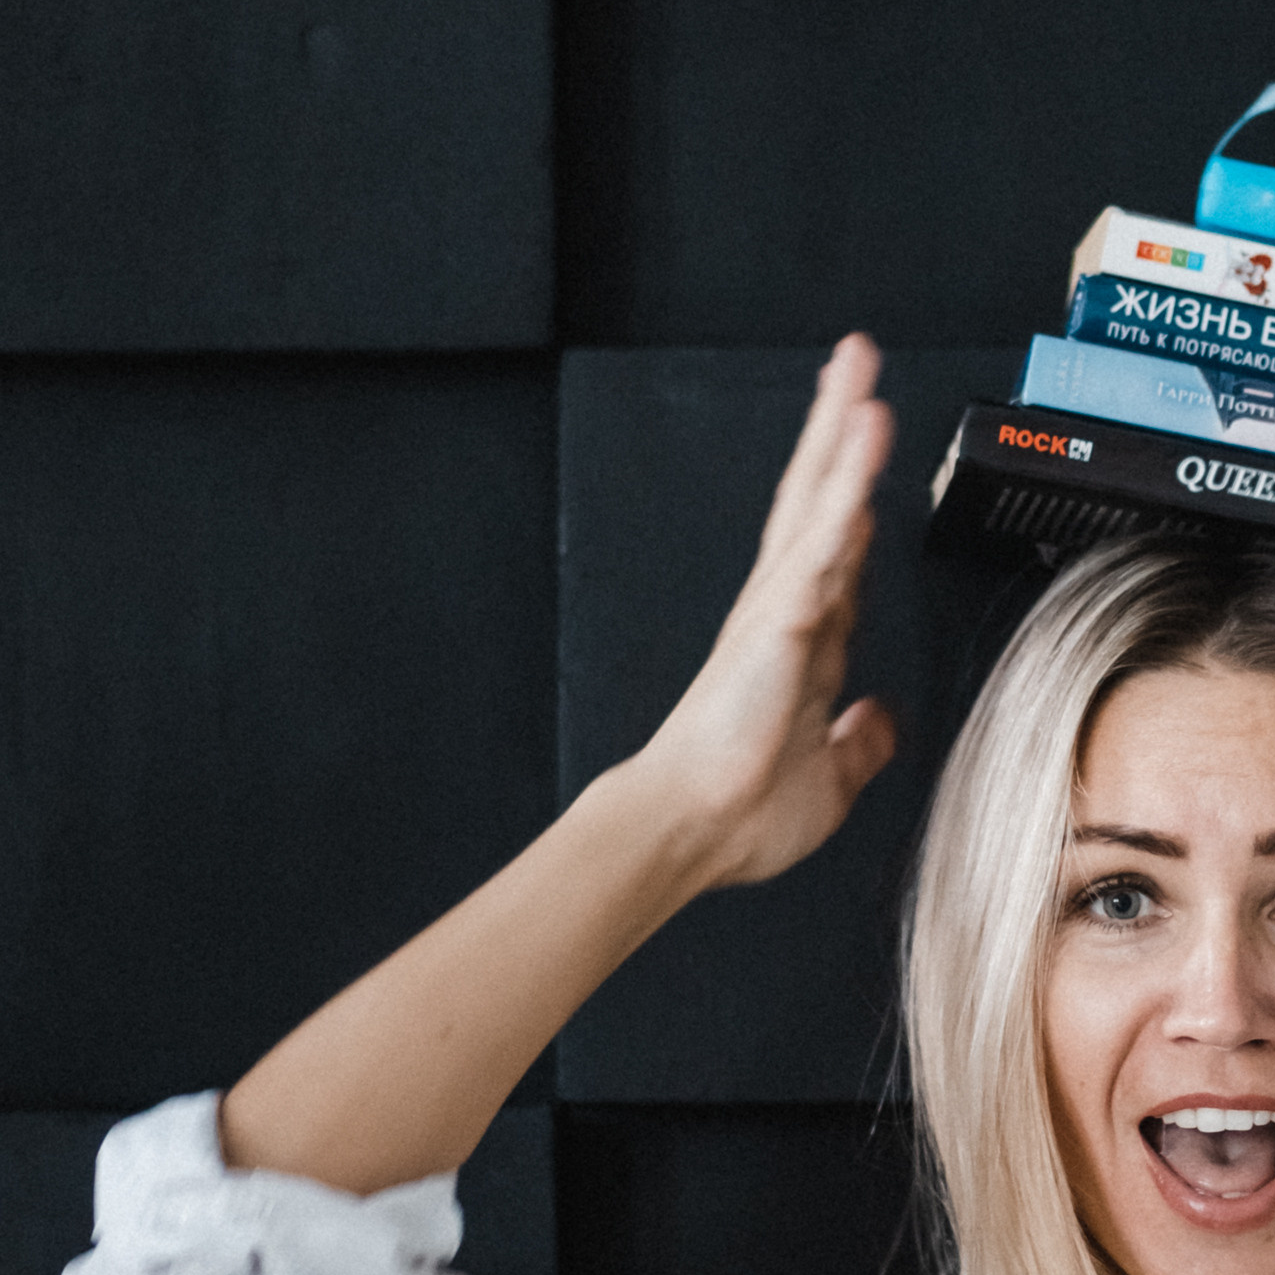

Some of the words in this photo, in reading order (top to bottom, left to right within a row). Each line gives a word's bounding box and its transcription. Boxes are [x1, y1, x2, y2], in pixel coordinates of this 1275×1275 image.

[1110, 283, 1252, 341] ЖИЗНЬ
[1107, 321, 1150, 345] ПУТЬ
[1156, 332, 1169, 349] К
[998, 425, 1068, 456] ROCK
